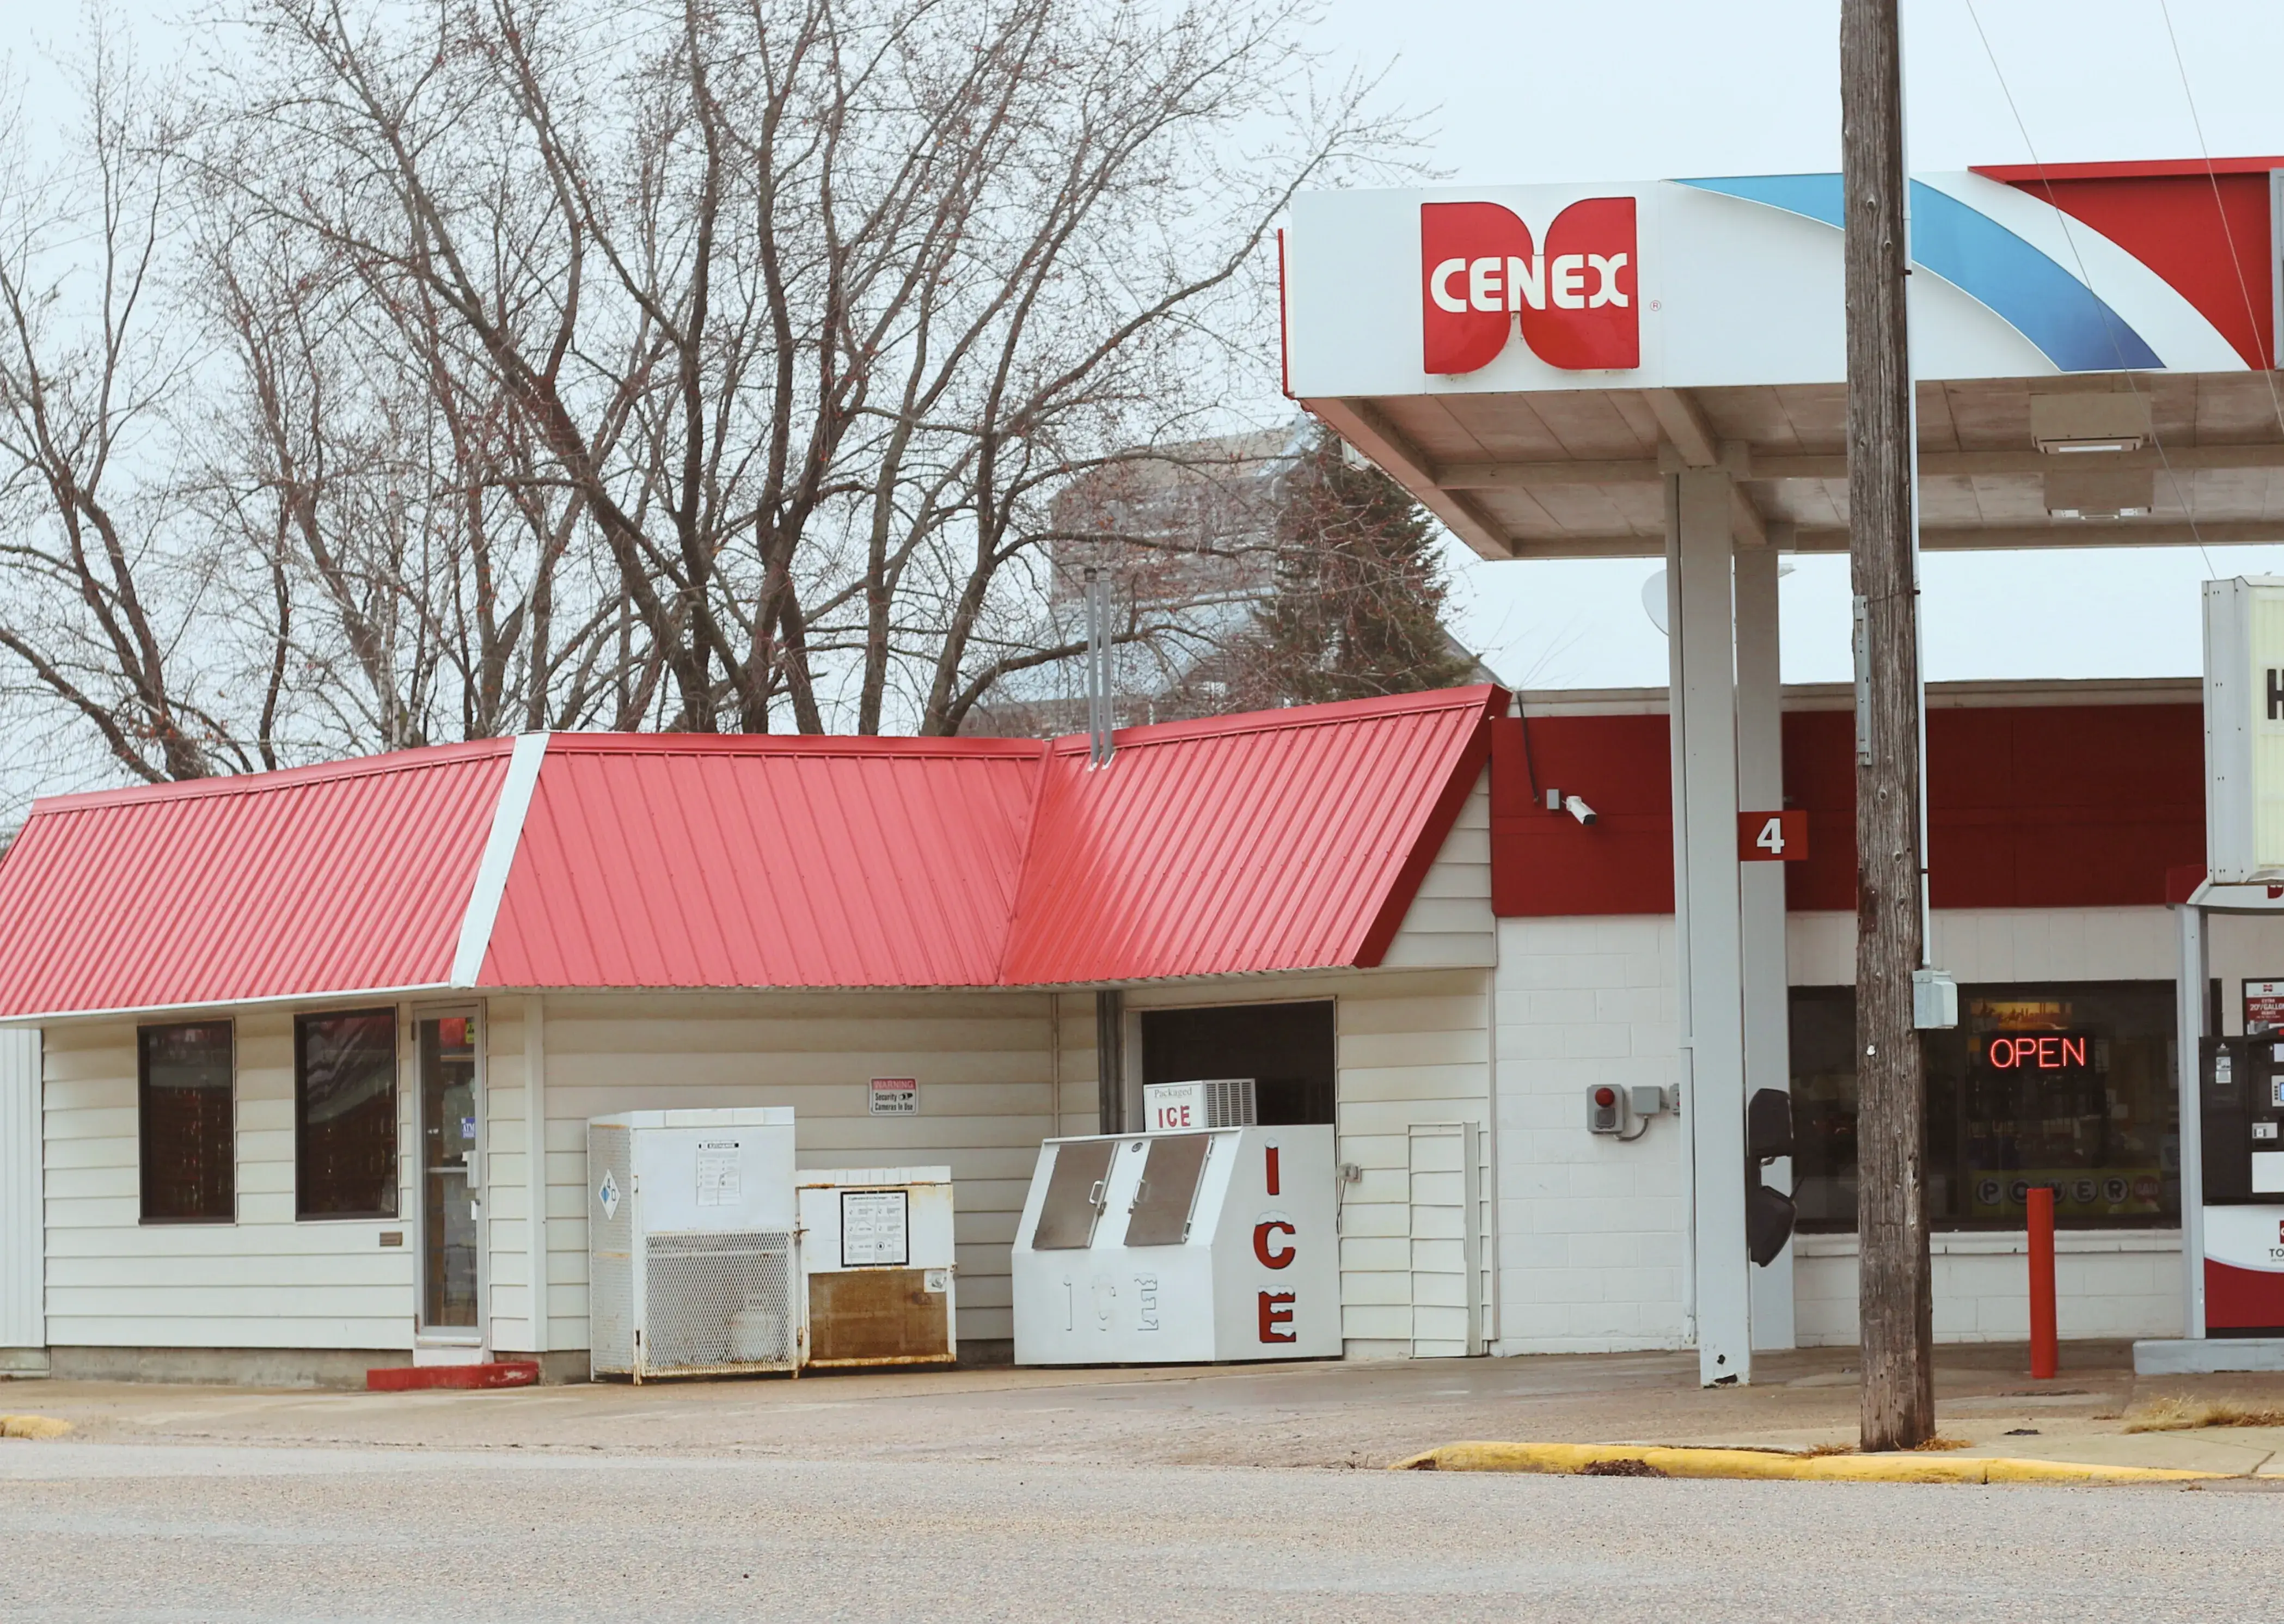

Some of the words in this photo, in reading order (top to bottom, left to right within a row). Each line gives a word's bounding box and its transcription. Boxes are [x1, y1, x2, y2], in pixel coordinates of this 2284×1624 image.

[1430, 252, 1628, 312] CENEX
[1756, 818, 1785, 854] 4
[1990, 1037, 2086, 1068] OPEN
[873, 1080, 915, 1089] WARNING
[1154, 1087, 1192, 1099] Packaged
[875, 1092, 897, 1102] Security
[875, 1102, 897, 1111] Cameras
[904, 1102, 913, 1111] Use
[1158, 1105, 1191, 1129] ICE
[1253, 1137, 1296, 1344] ICE
